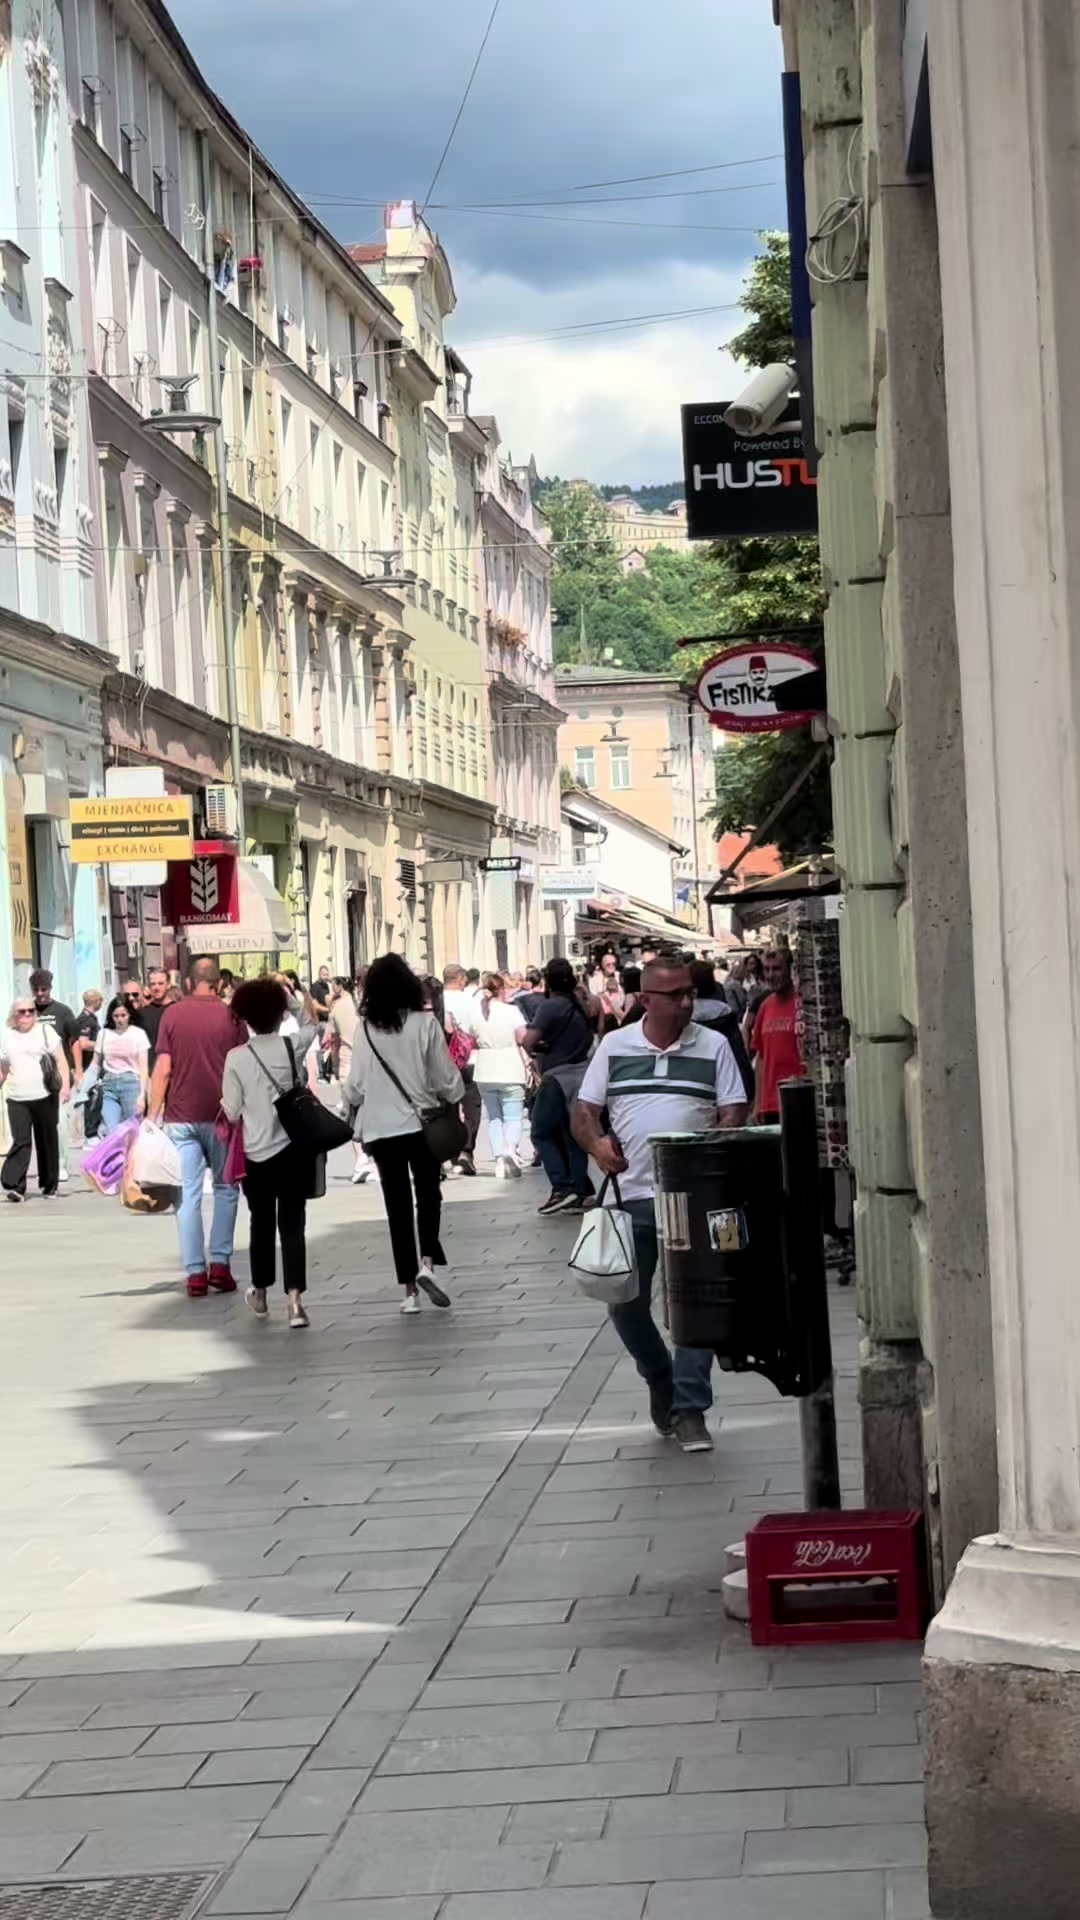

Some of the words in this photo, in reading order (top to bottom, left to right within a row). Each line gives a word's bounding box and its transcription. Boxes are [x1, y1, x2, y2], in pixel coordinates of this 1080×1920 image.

[733, 439, 790, 452] Powered
[84, 802, 174, 816] MJENJAČNICA
[97, 843, 165, 856] EXCHANGE
[180, 913, 232, 923] BANKOMAT
